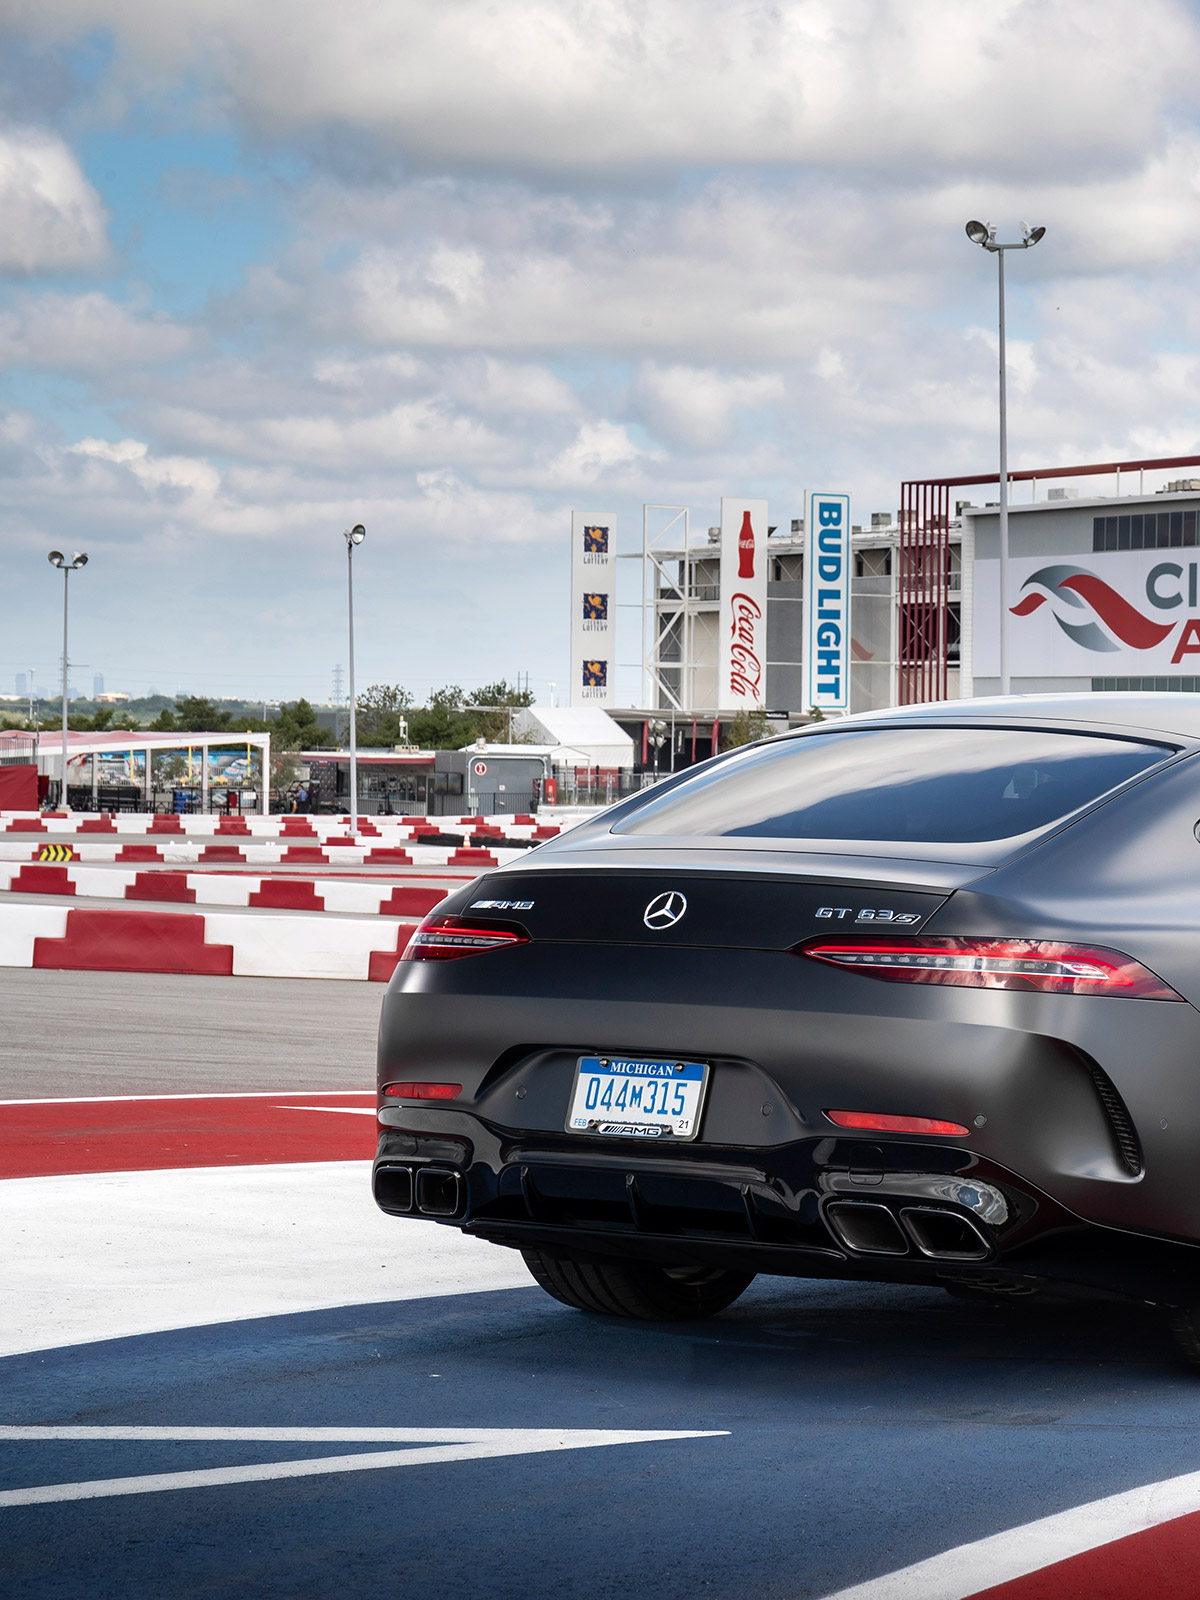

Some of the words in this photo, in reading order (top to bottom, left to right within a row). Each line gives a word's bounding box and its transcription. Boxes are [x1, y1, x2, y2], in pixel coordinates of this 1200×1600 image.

[818, 502, 842, 582] BUD
[582, 624, 608, 632] LOTTERY
[730, 592, 761, 703] Coca-Cola
[817, 589, 841, 699] LIGHT
[489, 900, 535, 910] AMG
[815, 907, 852, 919] GT
[610, 1061, 674, 1076] MICHIGAN
[585, 1077, 688, 1116] 044M315
[573, 1118, 587, 1127] FEB
[620, 1126, 660, 1136] AMG
